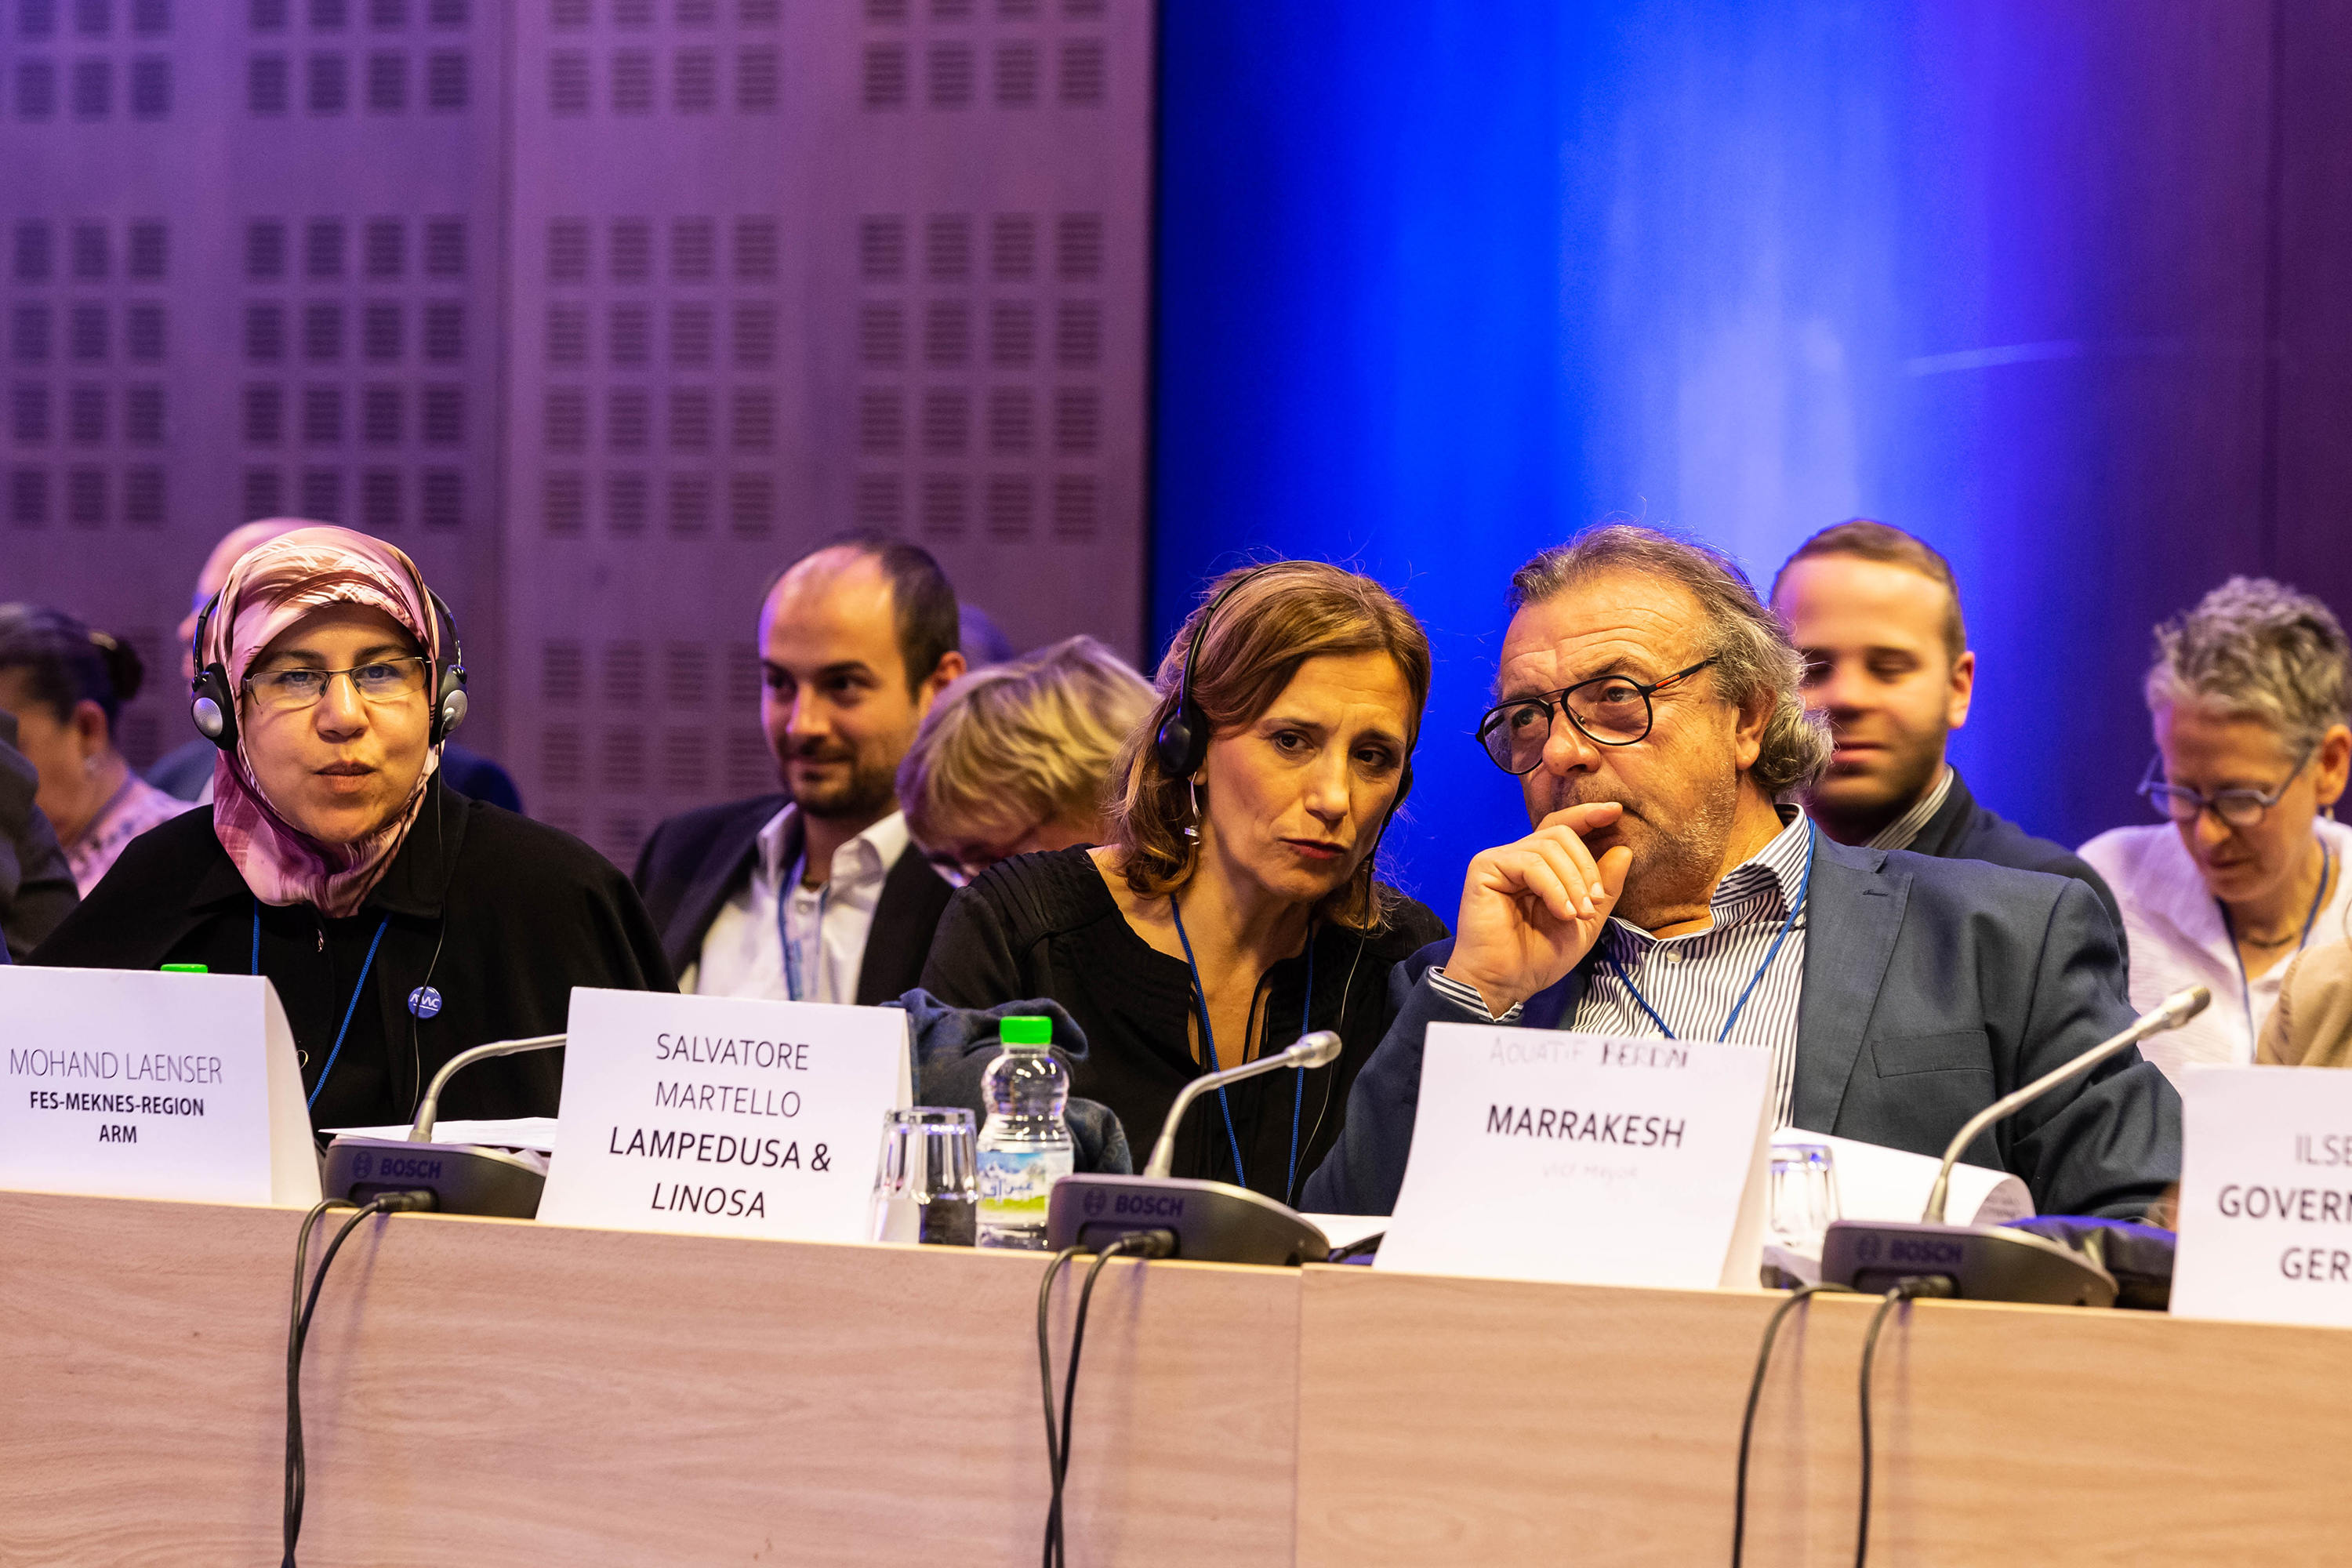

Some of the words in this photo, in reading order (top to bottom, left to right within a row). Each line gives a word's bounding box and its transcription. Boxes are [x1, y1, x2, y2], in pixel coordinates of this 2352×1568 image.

[9, 1048, 118, 1080] MOHAND
[125, 1053, 223, 1084] LAENSER
[656, 1033, 810, 1070] SALVATORE
[30, 1091, 205, 1116] FES-MEKNES-REGION
[655, 1081, 800, 1118] MARTELLO
[99, 1123, 138, 1144] ARM
[1486, 1104, 1686, 1149] MARRAKESH
[609, 1126, 800, 1169] LAMPEDUSA
[811, 1143, 832, 1172] &
[380, 1157, 442, 1179] BOSCH
[651, 1182, 765, 1219] LINOSA
[1114, 1195, 1185, 1218] BOSCH
[2218, 1184, 2352, 1223] GOVER
